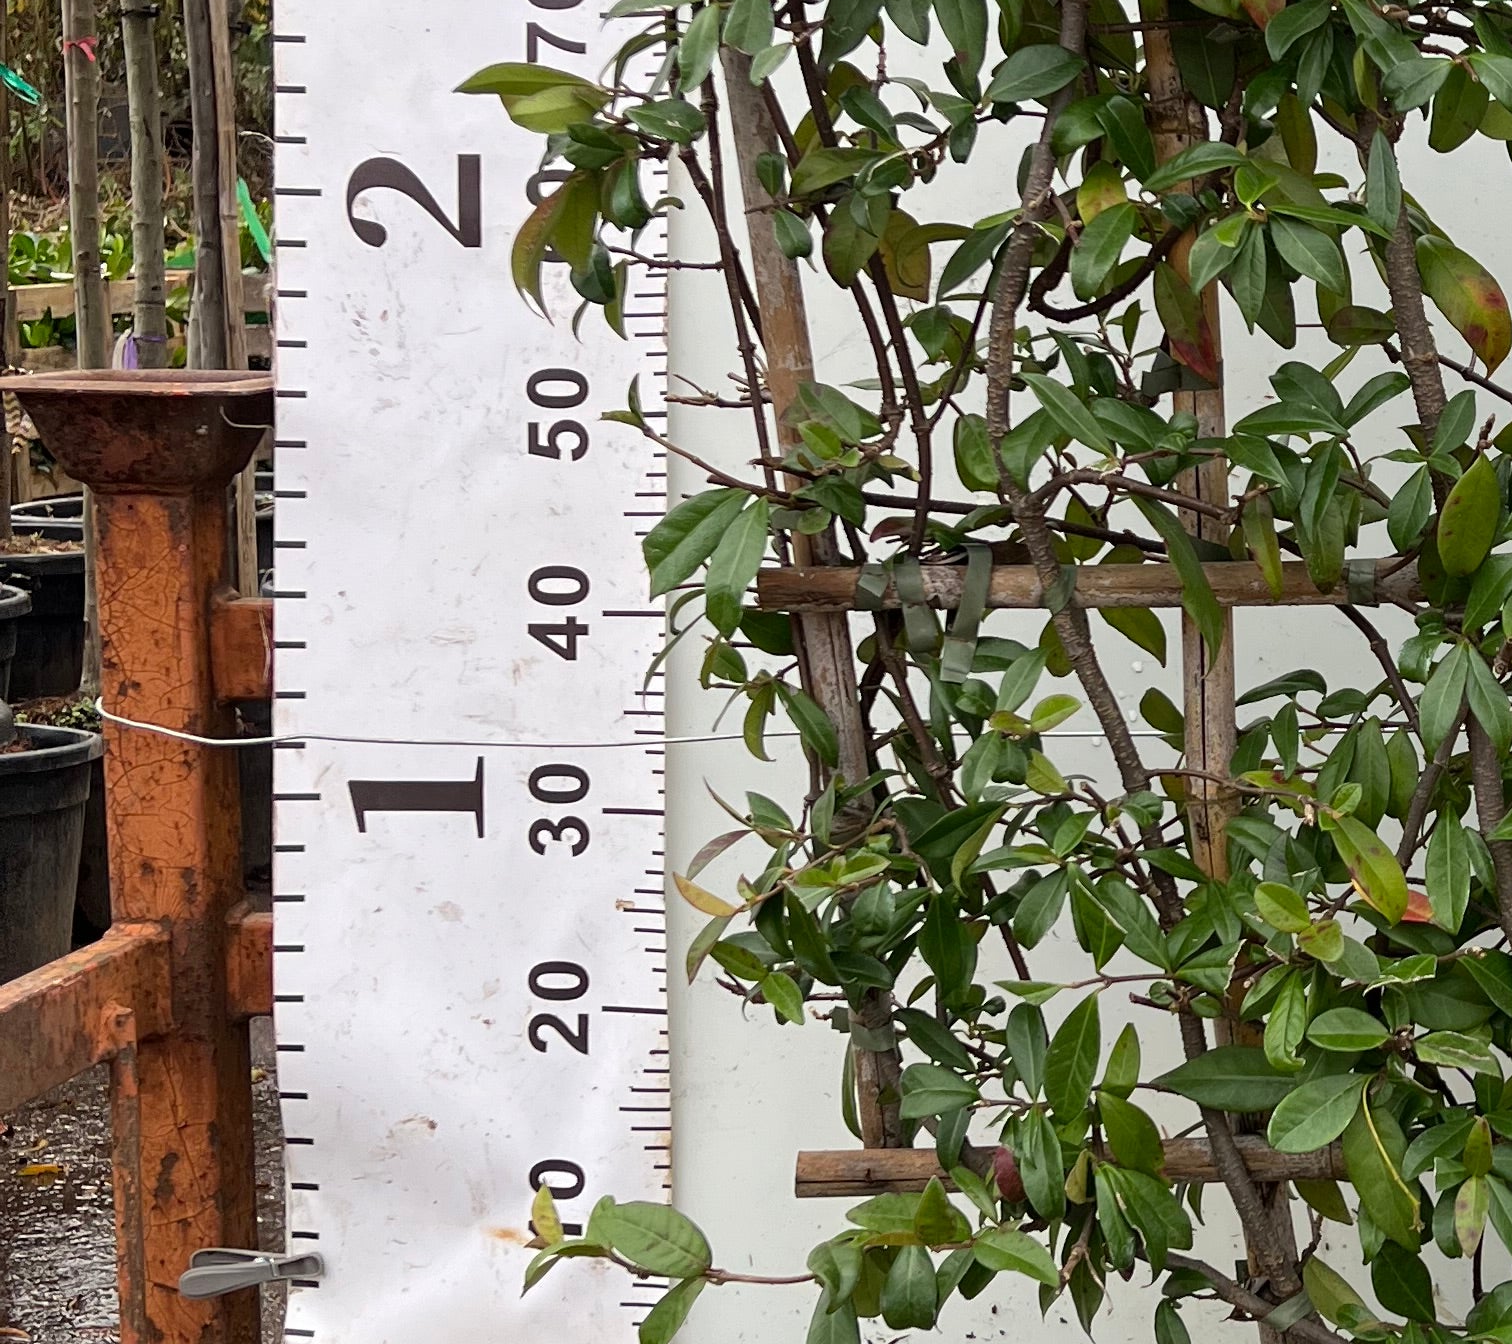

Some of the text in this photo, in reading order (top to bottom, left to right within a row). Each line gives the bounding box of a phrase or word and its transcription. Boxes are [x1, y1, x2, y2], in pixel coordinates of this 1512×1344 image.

[347, 154, 481, 248] 2
[526, 368, 589, 461] 50
[527, 565, 590, 661] 40
[348, 756, 483, 838] 1
[528, 763, 590, 856] 30
[528, 961, 589, 1055] 20
